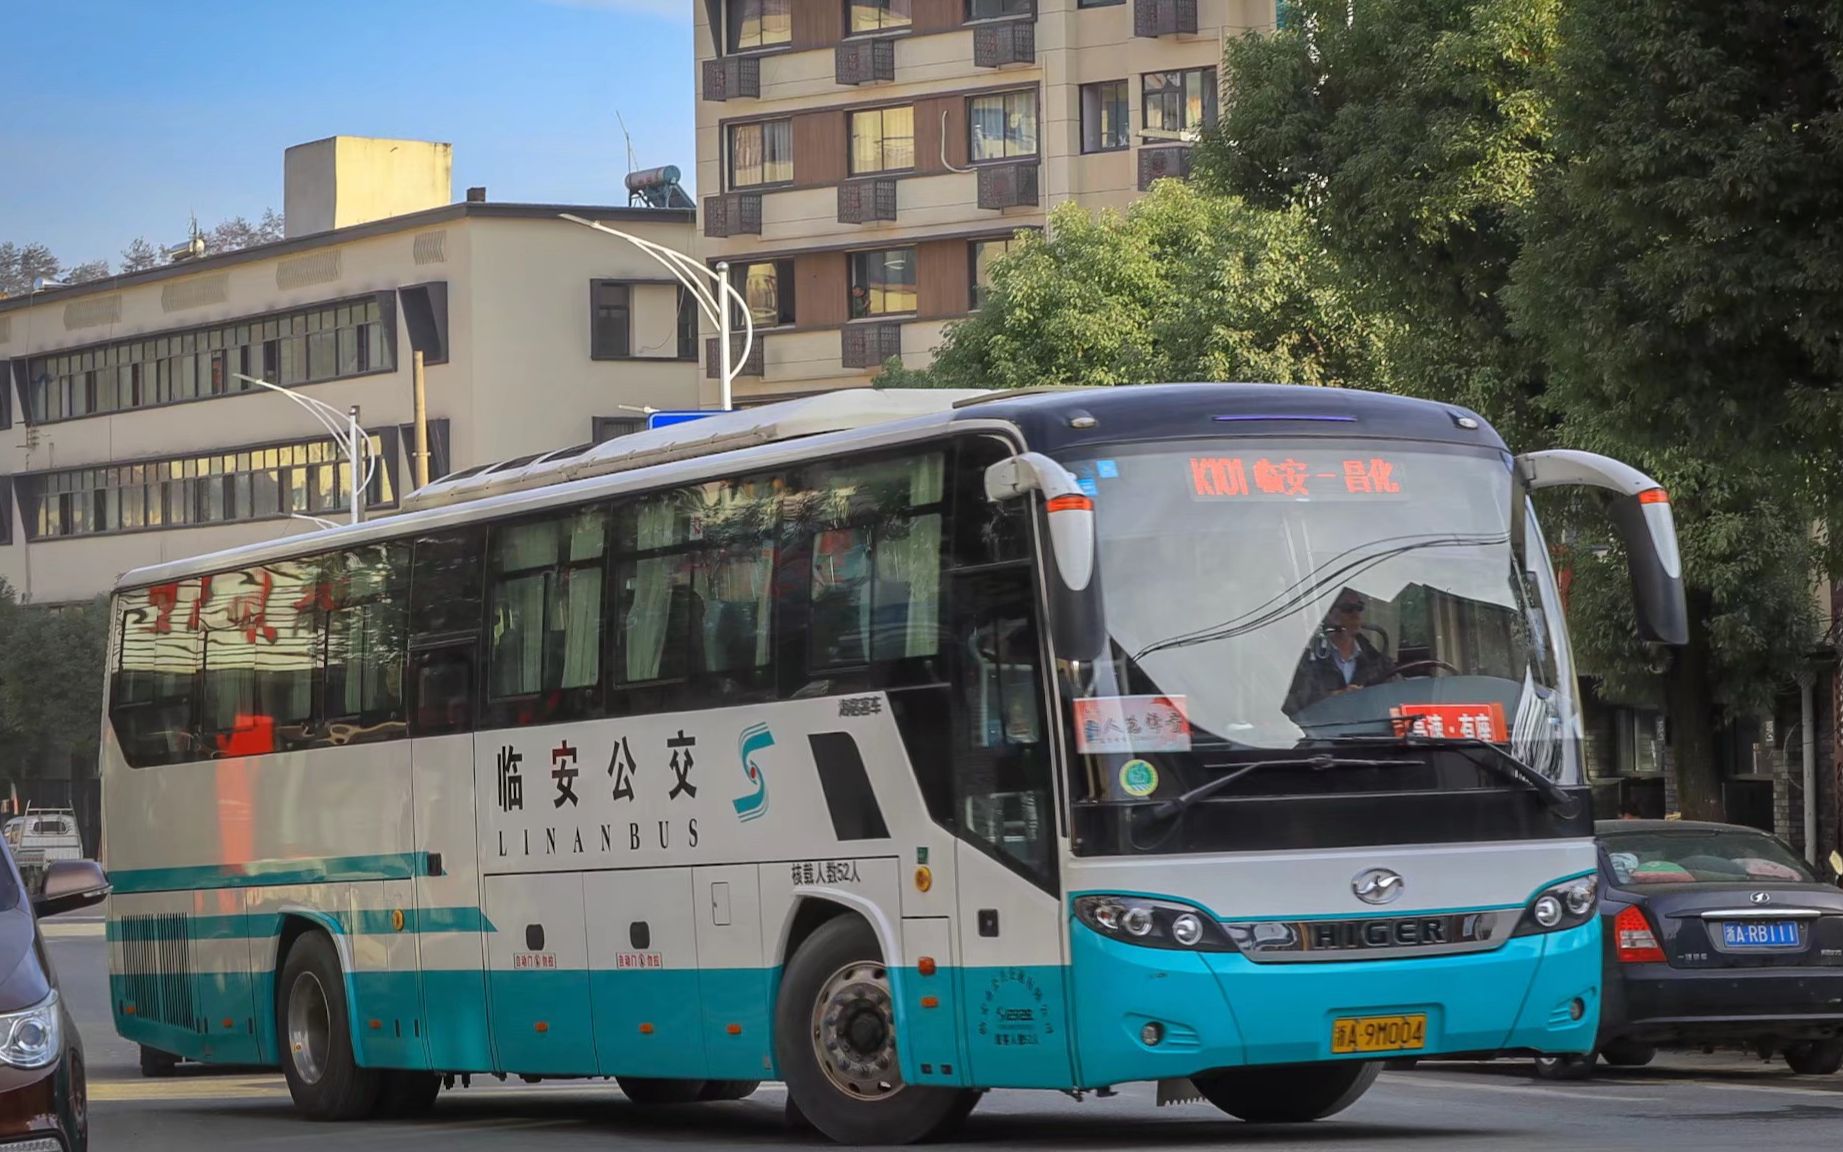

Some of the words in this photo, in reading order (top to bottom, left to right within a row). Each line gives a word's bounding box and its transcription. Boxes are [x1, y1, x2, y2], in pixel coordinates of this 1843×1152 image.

[497, 730, 697, 813] 临安公交
[498, 818, 699, 857] LINANBUS
[1312, 919, 1447, 950] HIGER
